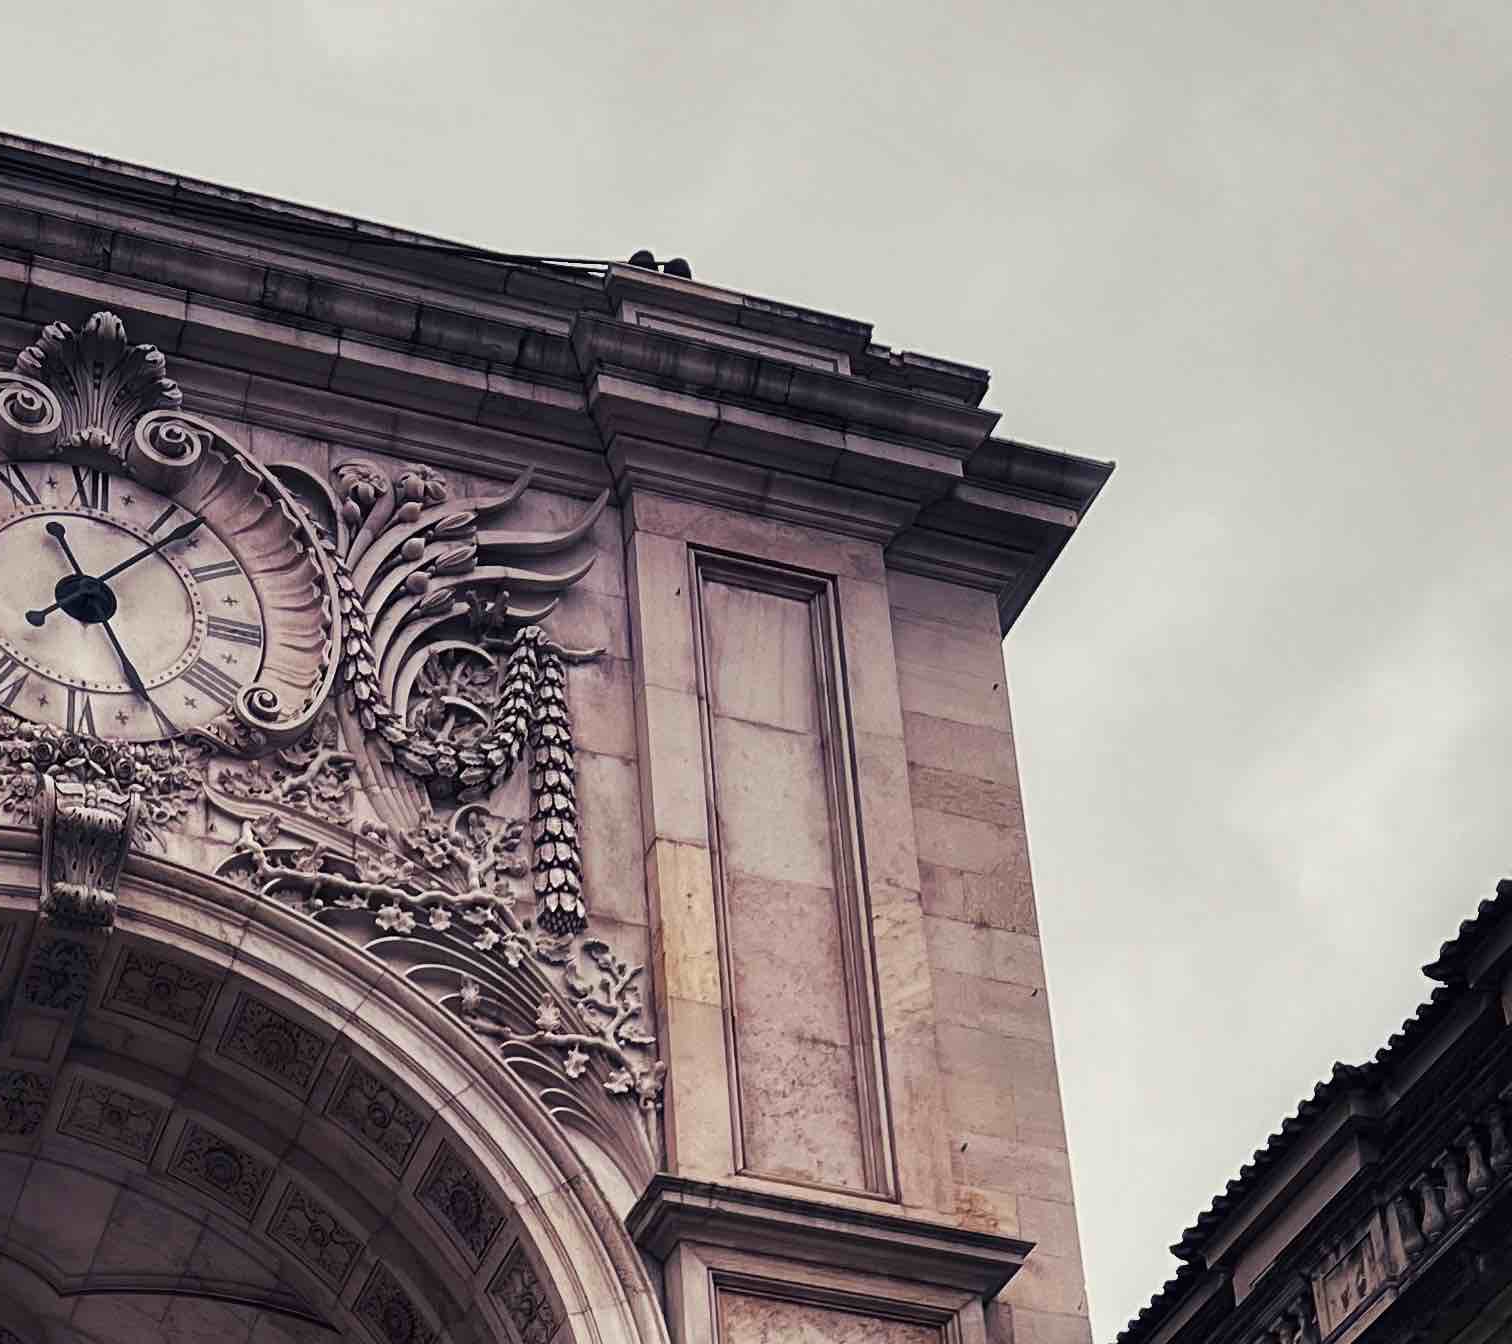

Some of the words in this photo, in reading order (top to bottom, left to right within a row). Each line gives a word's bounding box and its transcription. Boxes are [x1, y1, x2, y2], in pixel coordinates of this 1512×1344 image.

[70, 465, 110, 513] XII
[191, 560, 244, 583] II
[207, 615, 262, 649] III
